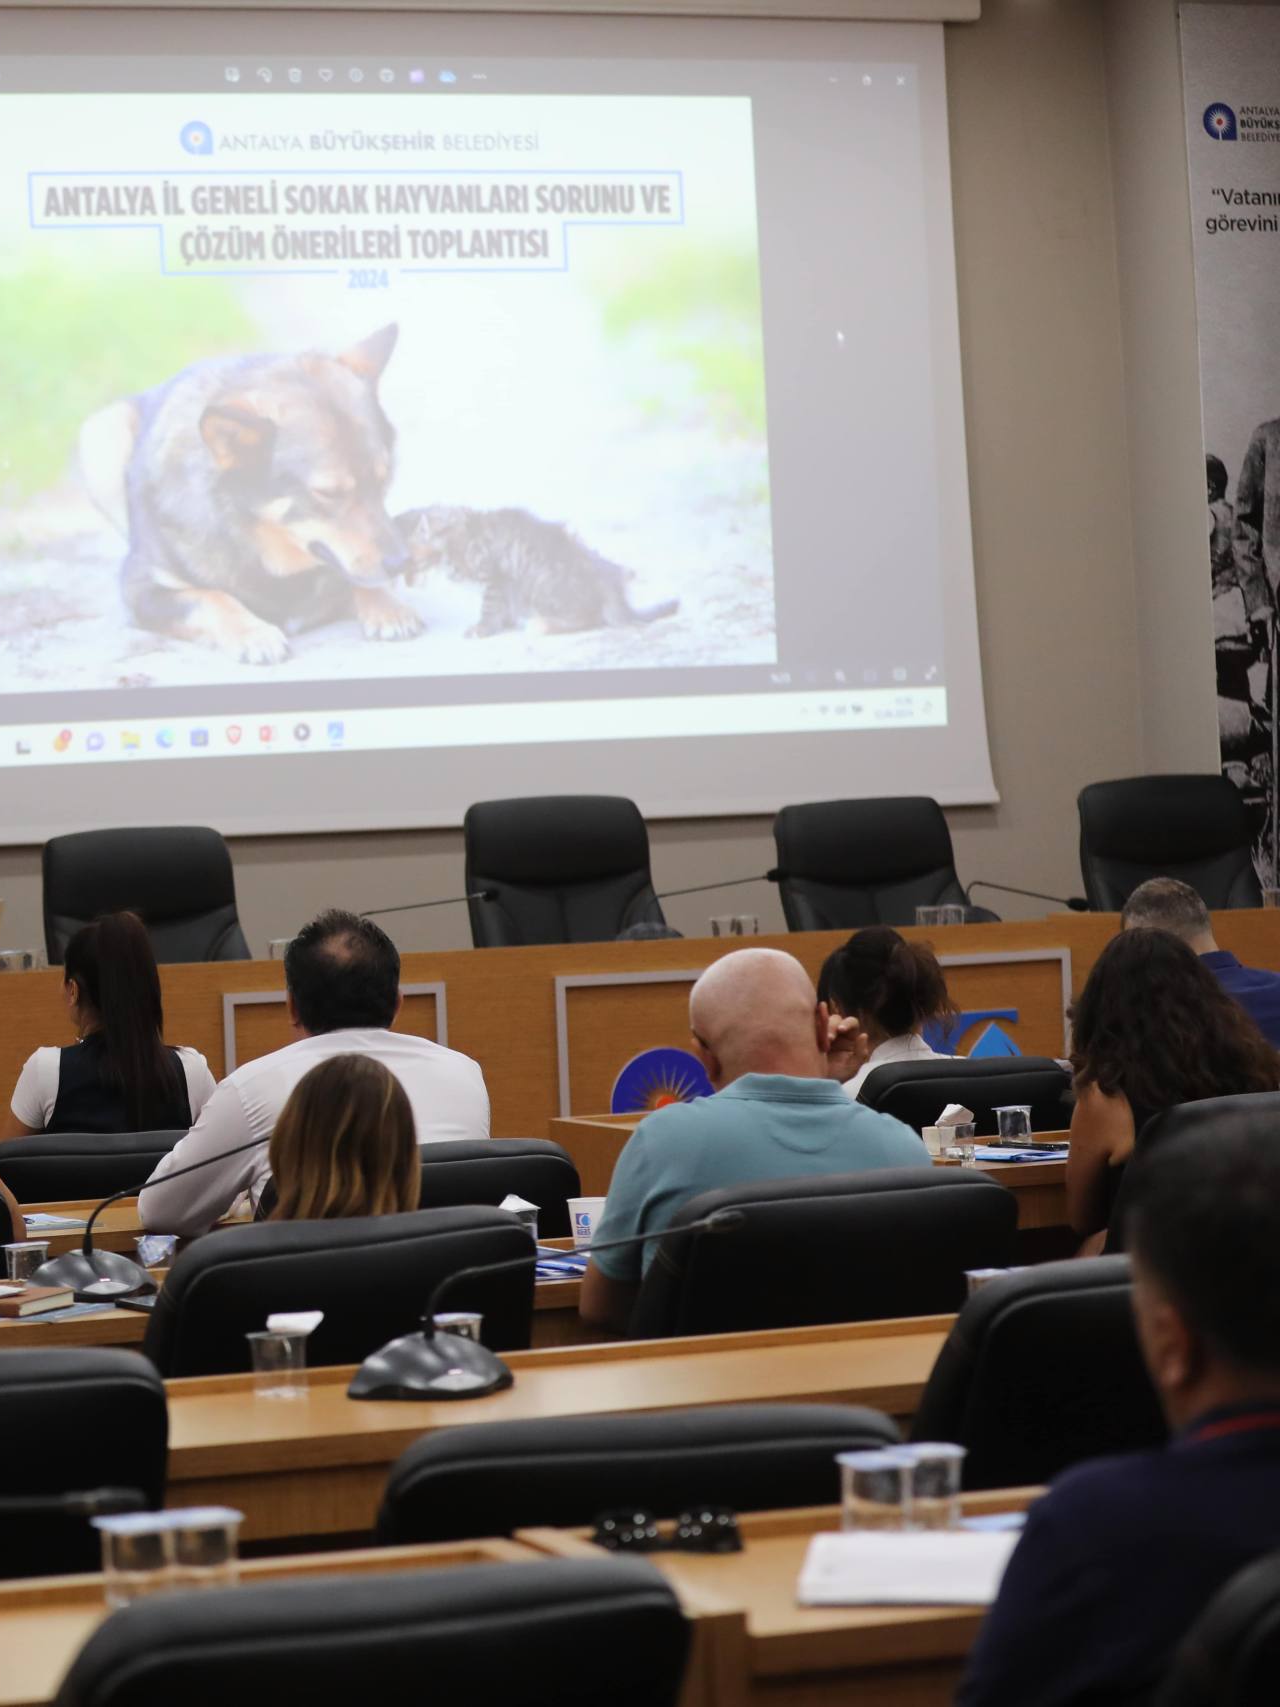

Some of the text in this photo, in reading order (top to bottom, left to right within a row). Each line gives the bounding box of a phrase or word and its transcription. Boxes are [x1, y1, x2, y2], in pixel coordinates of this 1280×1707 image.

[220, 130, 540, 155] ANTALYA BÜYÜKŞEHİR BELEDİYESİ
[43, 180, 671, 217] ANTALYA İL GENELİ SOKAK HAYVANLARI SORUNU VE
[1206, 214, 1278, 235] görevini
[180, 225, 550, 265] ÇÖZÜM ÖNERİLERİ TOPLANTISI
[347, 269, 390, 289] 2024
